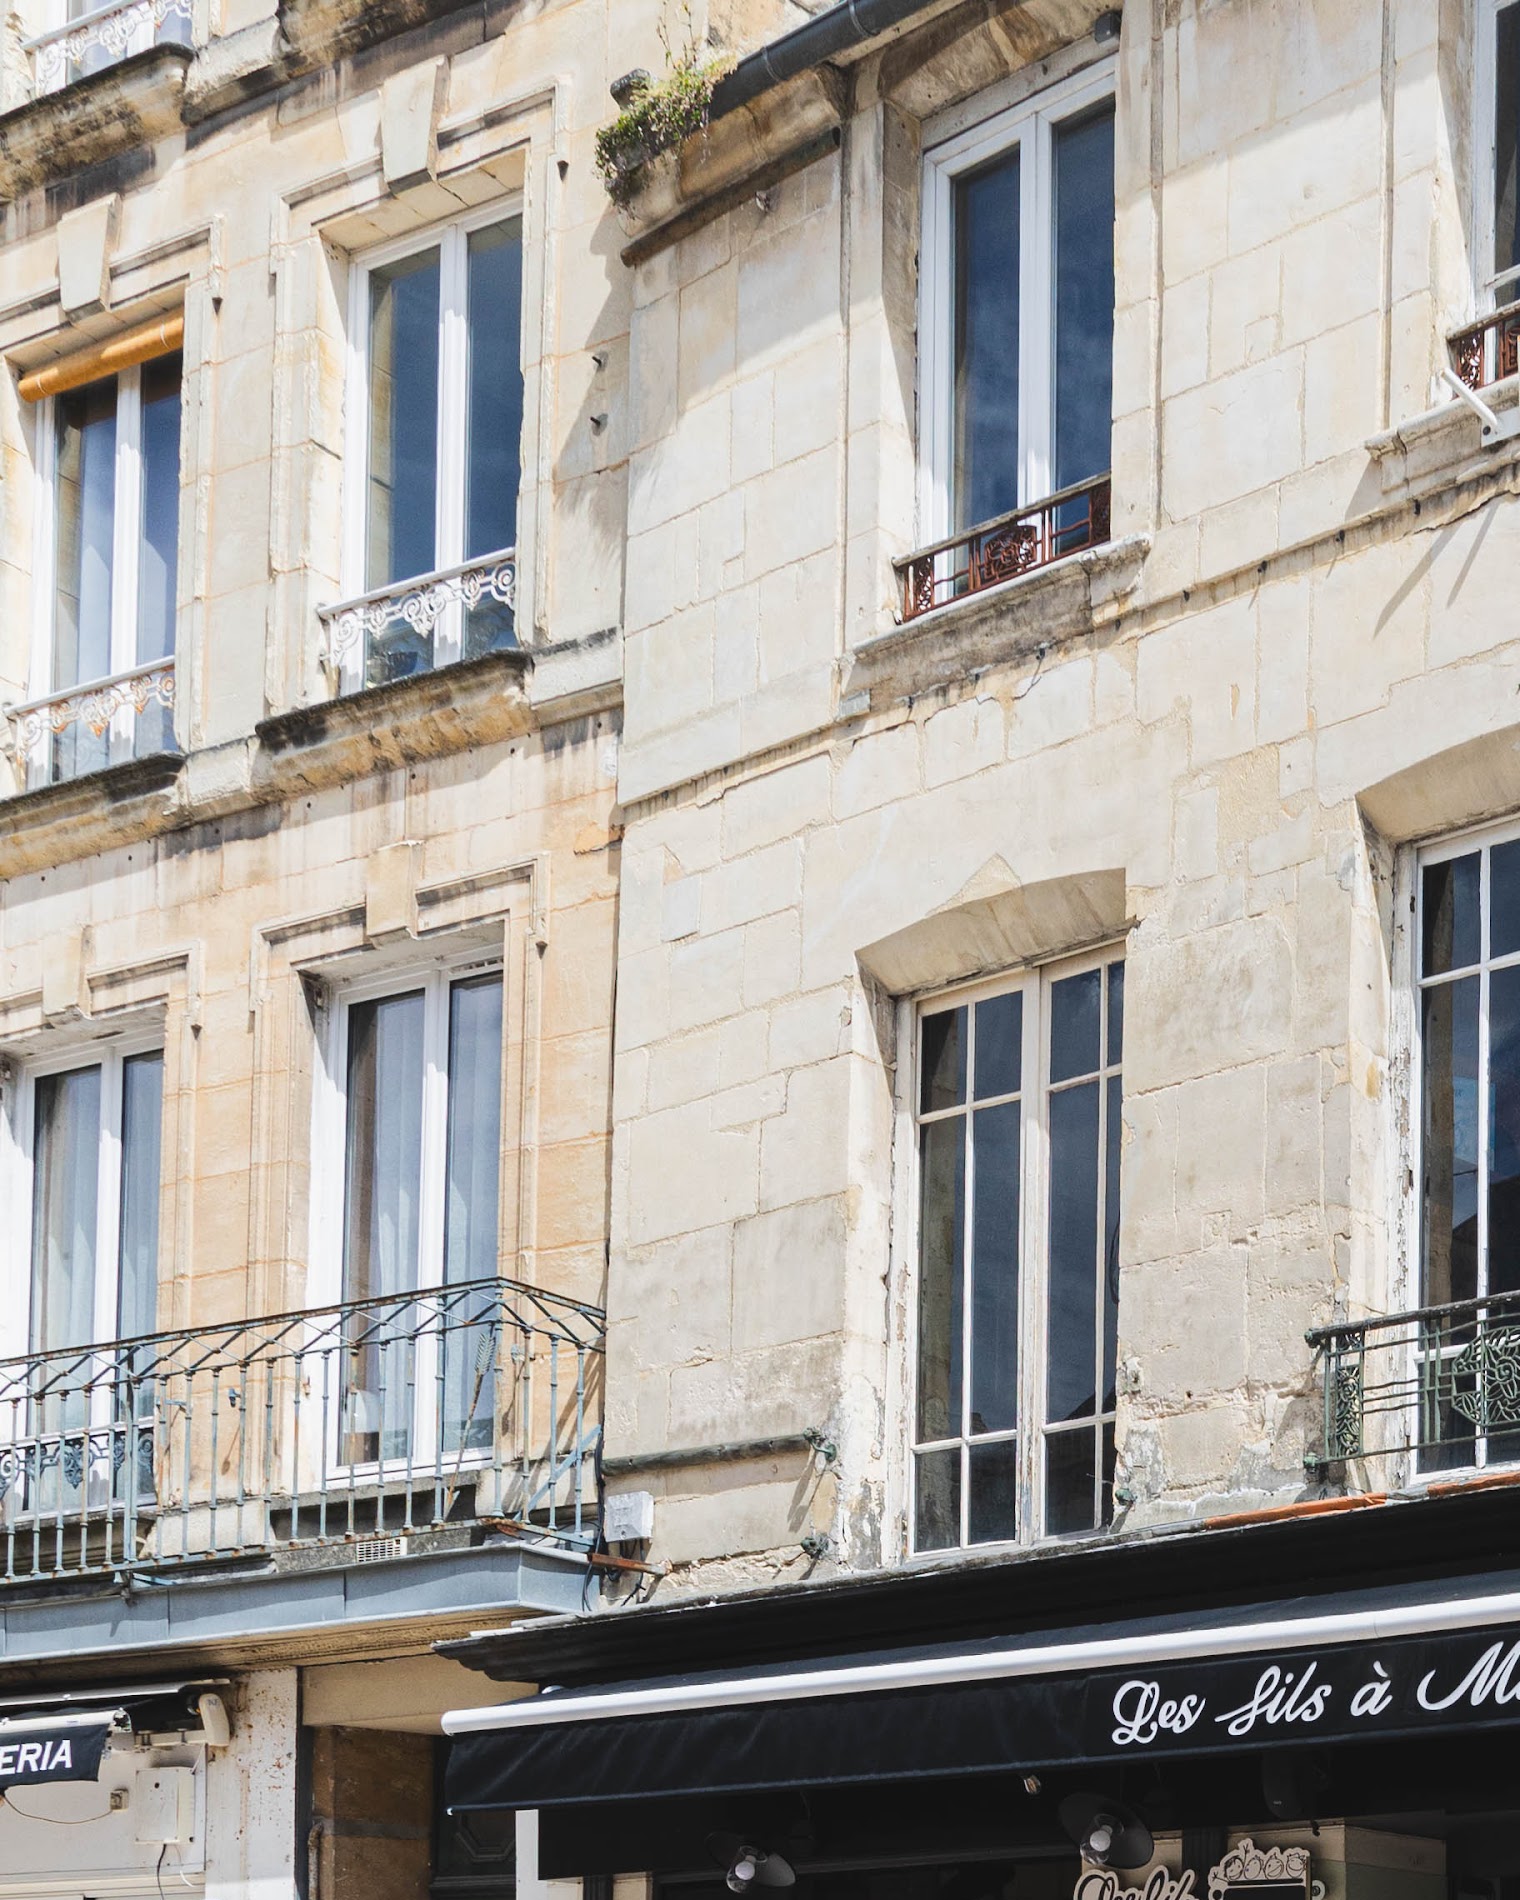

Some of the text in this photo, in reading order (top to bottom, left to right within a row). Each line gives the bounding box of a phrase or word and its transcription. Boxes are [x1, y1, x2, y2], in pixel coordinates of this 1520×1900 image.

[1111, 1680, 1206, 1746] Les
[1215, 1661, 1331, 1736] fils
[1350, 1661, 1394, 1717] à
